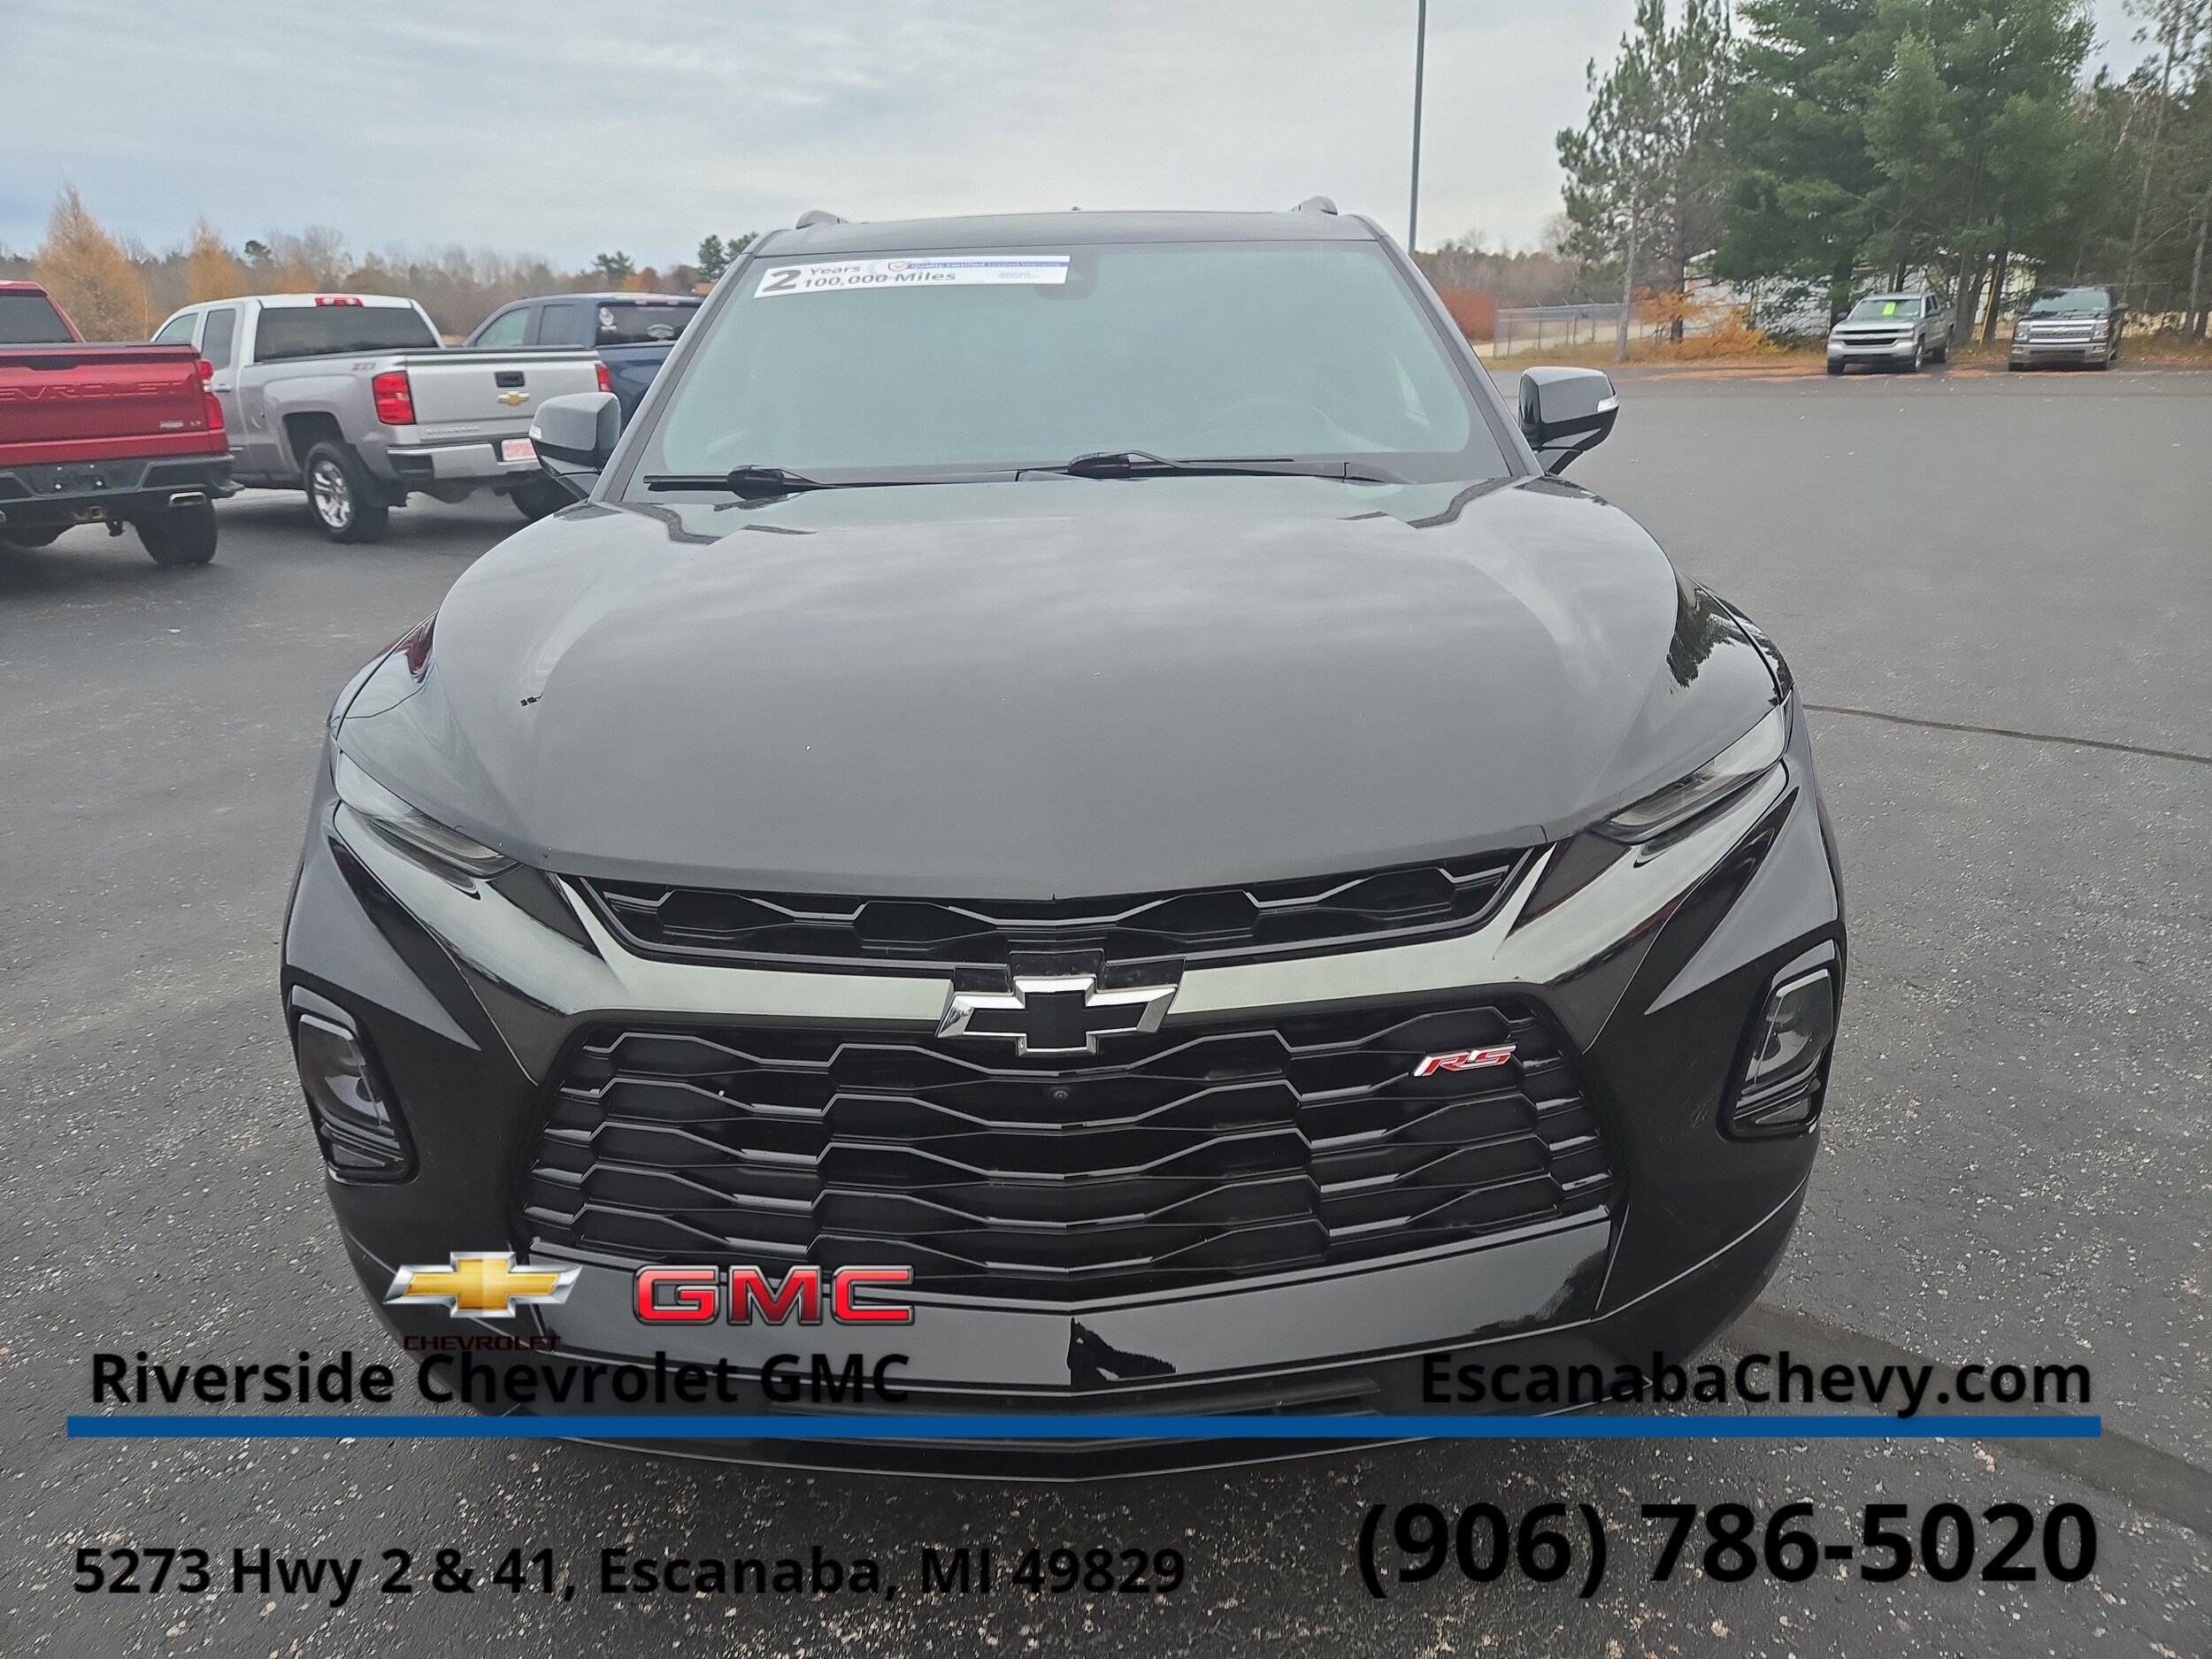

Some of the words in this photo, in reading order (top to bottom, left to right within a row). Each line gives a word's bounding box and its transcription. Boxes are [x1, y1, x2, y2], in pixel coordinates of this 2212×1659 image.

[810, 265, 861, 275] Years
[762, 269, 802, 293] 2
[803, 273, 888, 288] 100,000
[895, 273, 956, 282] Miles
[1413, 1044, 1517, 1077] RS
